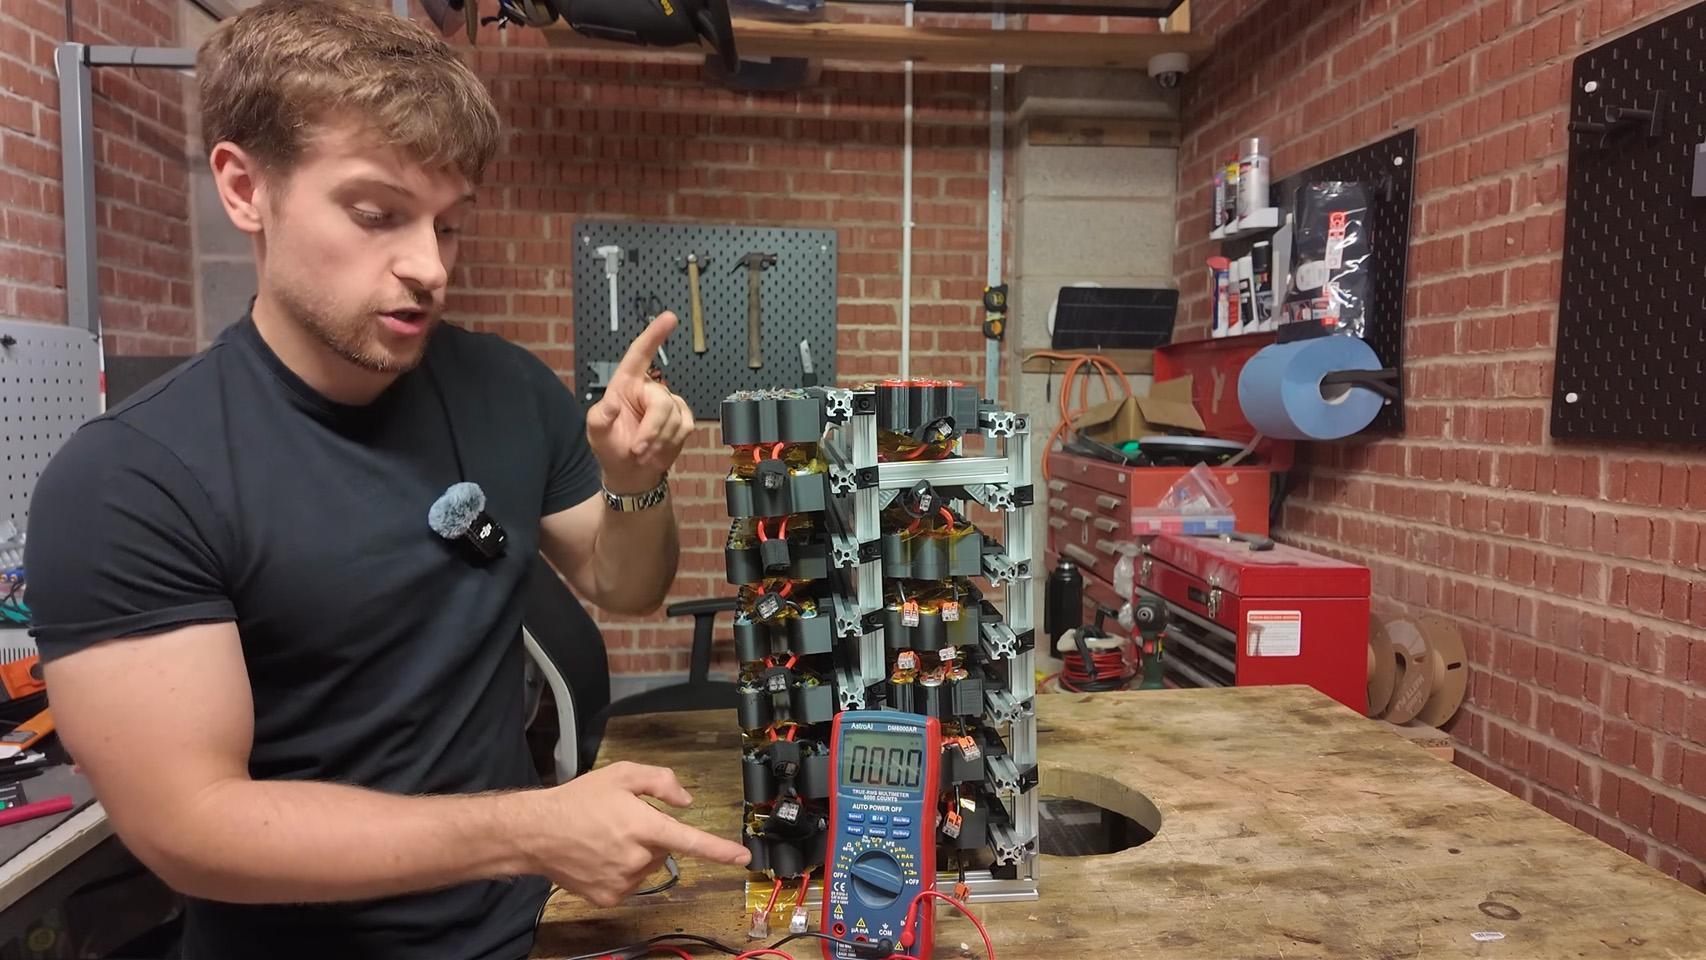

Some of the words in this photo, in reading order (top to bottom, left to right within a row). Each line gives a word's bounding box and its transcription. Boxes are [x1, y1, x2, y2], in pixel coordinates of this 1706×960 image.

[851, 722, 874, 731] AstroAI
[849, 745, 922, 788] 000.0
[879, 790, 910, 798] MULTIMETER
[868, 804, 890, 812] POWER
